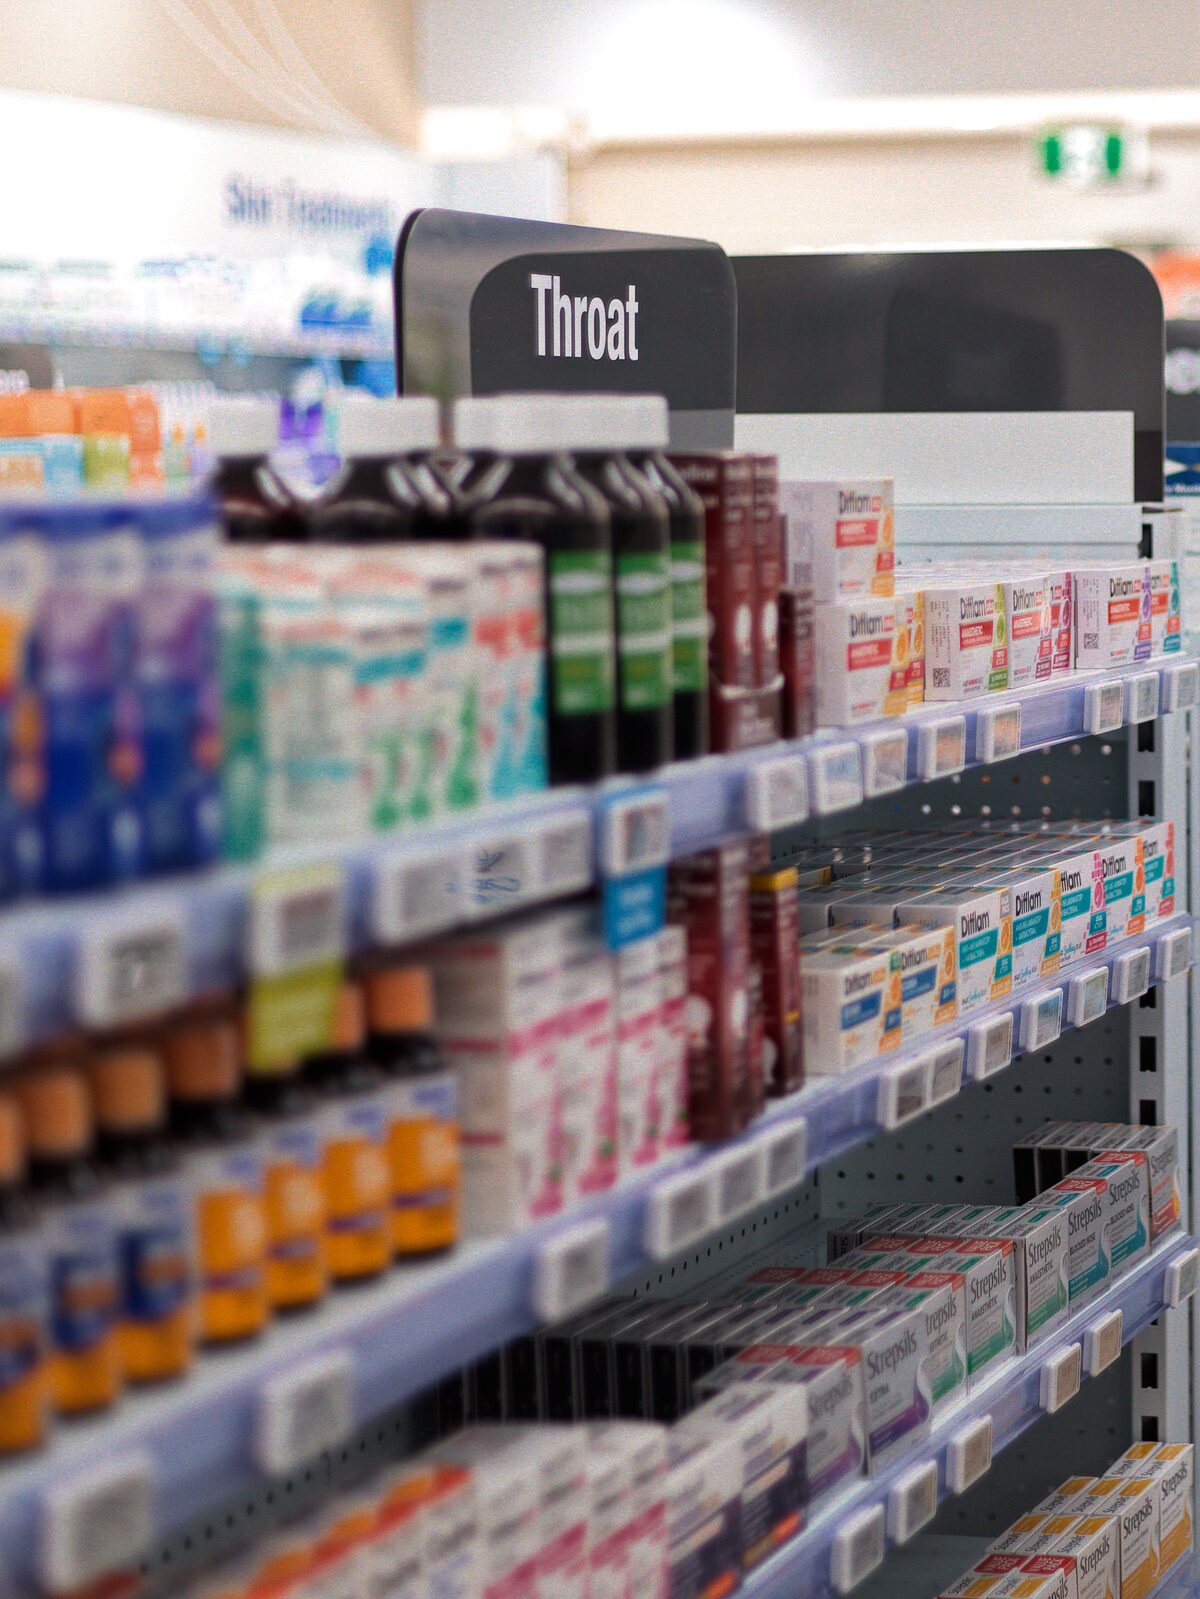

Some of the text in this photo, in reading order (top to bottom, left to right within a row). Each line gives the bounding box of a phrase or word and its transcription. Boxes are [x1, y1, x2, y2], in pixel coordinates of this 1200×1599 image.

[531, 274, 638, 361] Throat
[839, 490, 870, 514] Difflam
[1013, 589, 1035, 611] Difflam
[1110, 577, 1133, 597] Difflam
[960, 596, 985, 620] Difflam
[850, 611, 883, 637] Difflam
[1102, 855, 1127, 878] Difflam
[1061, 871, 1082, 892] fflam
[1015, 890, 1042, 917] Difflam
[961, 911, 990, 938] Difflam
[901, 949, 928, 972] Difflam
[1109, 1169, 1140, 1206] Strepsils
[1068, 1196, 1102, 1236] Strepsils
[1028, 1226, 1062, 1268] Strepsils
[970, 1259, 1007, 1305] Strepsils
[1029, 1260, 1054, 1284] ANAESTHETIC
[926, 1294, 957, 1336] trepsils
[971, 1295, 998, 1321] ANAESTHETIC
[866, 1328, 917, 1380] Strepsils
[1161, 1461, 1188, 1500] Strepsils
[1123, 1497, 1153, 1539] Strepsils
[1080, 1533, 1110, 1580] Strepsils
